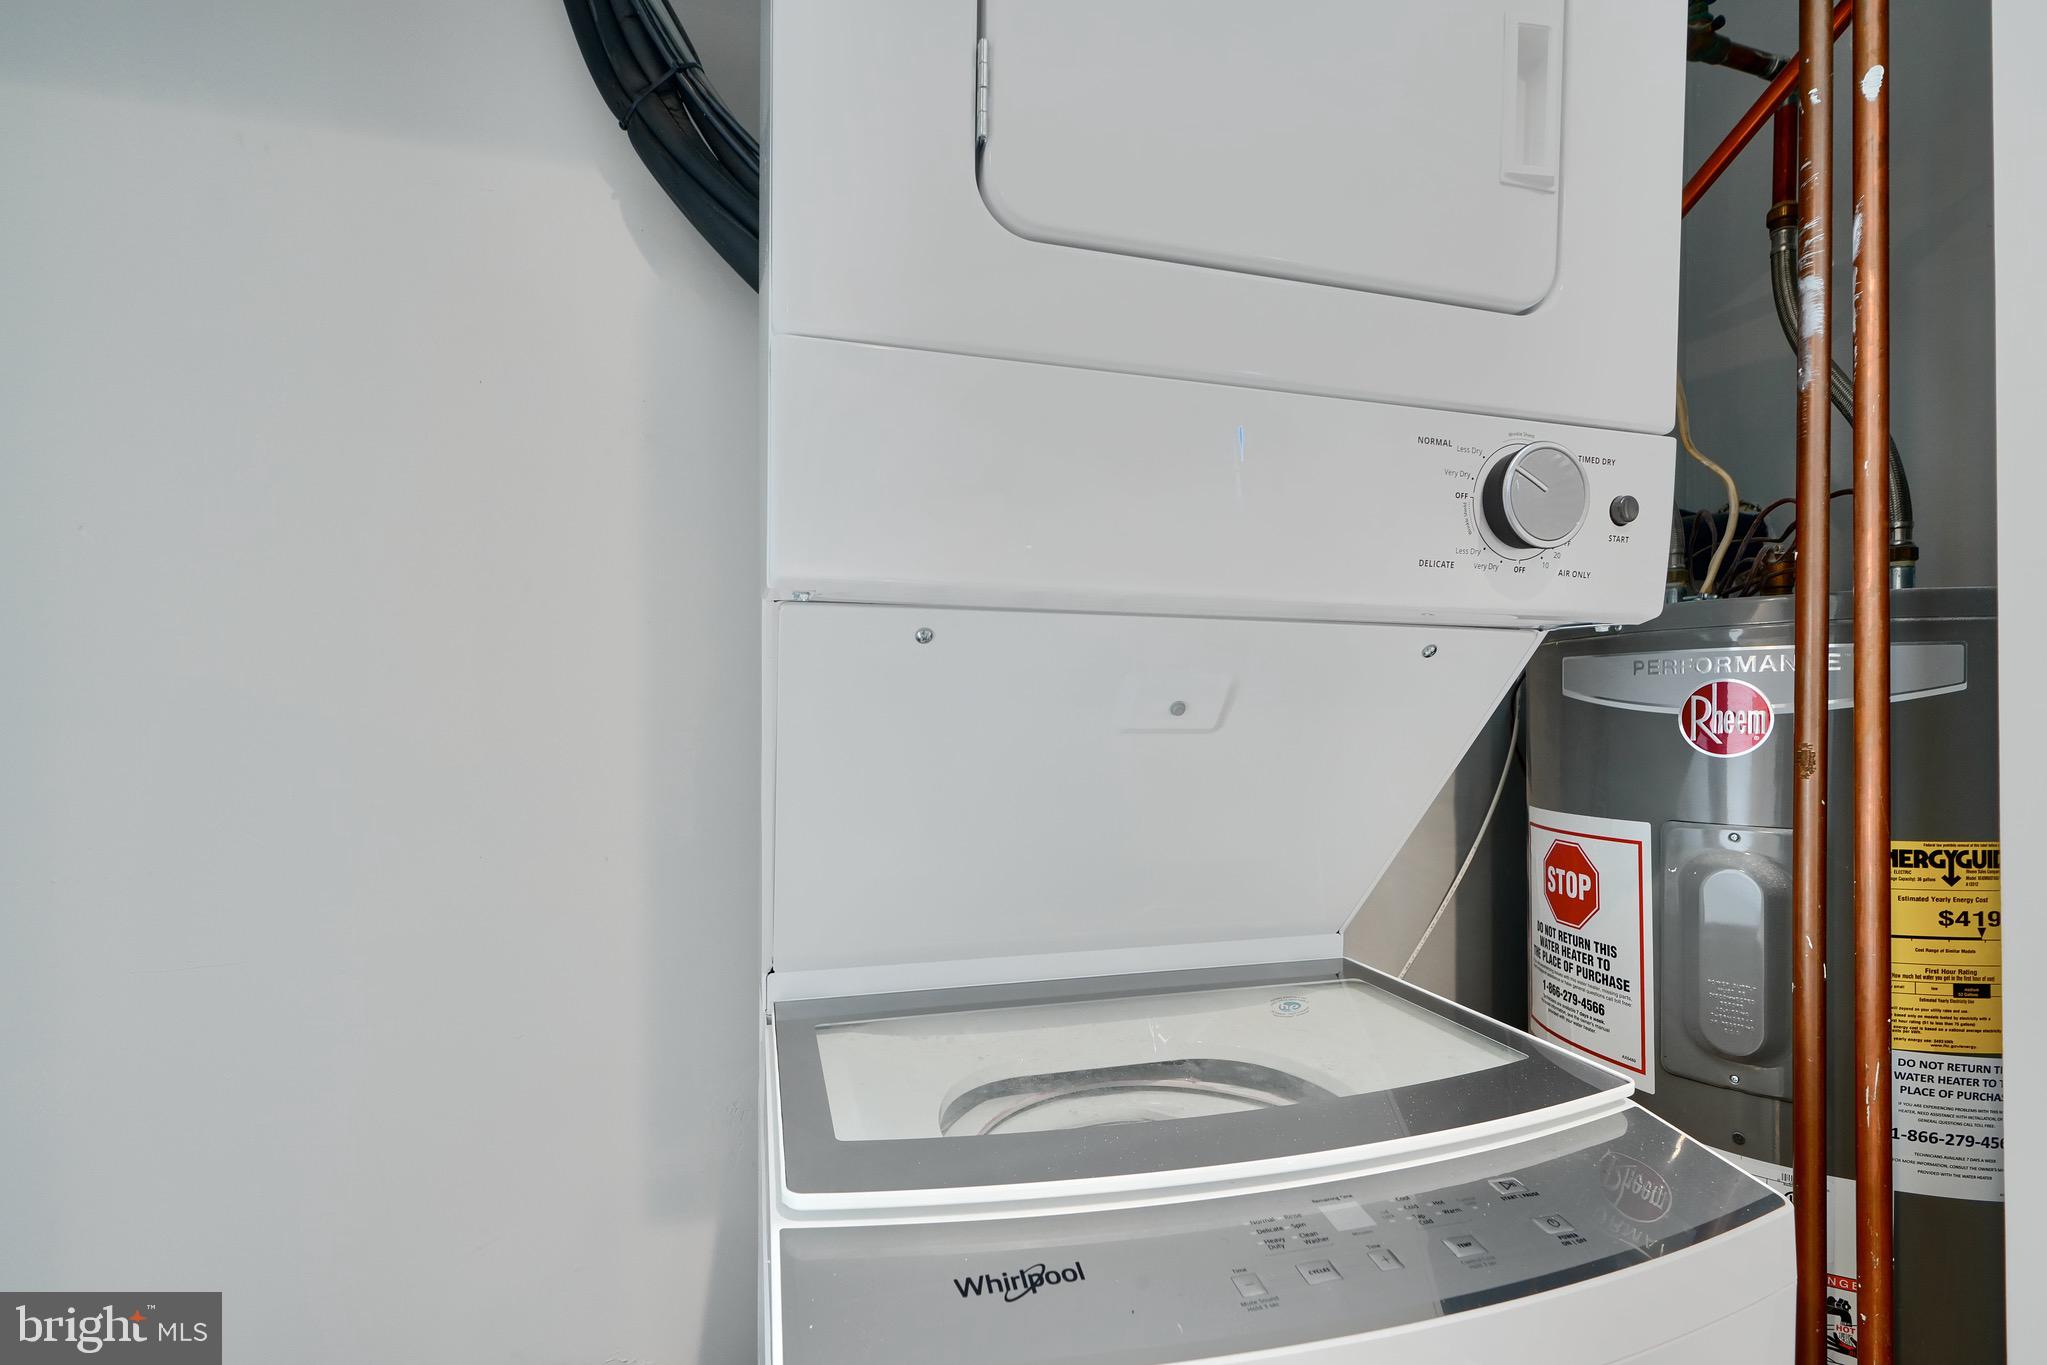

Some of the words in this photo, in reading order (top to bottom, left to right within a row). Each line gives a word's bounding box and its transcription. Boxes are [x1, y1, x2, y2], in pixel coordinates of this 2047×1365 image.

[1417, 436, 1452, 448] NORMAL
[1456, 445, 1471, 454] Less
[1471, 447, 1483, 456] Dry
[1578, 455, 1600, 465] TIMED
[1601, 458, 1616, 467] DRY
[1444, 469, 1459, 478] Very
[1459, 470, 1471, 479] Dry
[1608, 535, 1630, 544] START
[1455, 547, 1469, 555] Less
[1470, 548, 1481, 557] Dry
[1418, 559, 1455, 569] DELICATE
[1474, 562, 1487, 572] Very
[1488, 563, 1499, 573] Dry
[1513, 566, 1526, 574] OFF
[1558, 569, 1571, 578] AIR
[1572, 570, 1591, 579] ONLY
[1633, 652, 1841, 676] PERFORMANE
[1690, 682, 1767, 745] Rheem
[1547, 866, 1591, 901] STOP
[1897, 895, 1929, 903] Estimated
[1931, 896, 1951, 904] Yearly
[1938, 909, 2000, 928] $419
[1537, 920, 1544, 932] DO
[1545, 927, 1557, 939] NOT
[1558, 930, 1591, 951] RETURN
[1593, 940, 1617, 958] THIS
[1540, 935, 1560, 955] WATER
[1561, 945, 1594, 966] HEATER
[1597, 956, 1610, 971] TO
[1542, 950, 1561, 969] PLACE
[1563, 960, 1573, 973] OF
[1576, 964, 1630, 992] PURCHASE
[1542, 979, 1605, 1016] 1-866-279-4566
[1897, 1058, 1916, 1068] DO
[1919, 1061, 1944, 1071] NOT
[1946, 1063, 1991, 1074] RETURN
[1894, 1071, 1935, 1083] WATER
[1937, 1076, 1980, 1087] HEATER
[1982, 1079, 1997, 1088] TO
[1899, 1085, 1935, 1097] PLACE
[1938, 1089, 1954, 1099] OF
[1956, 1091, 2003, 1102] PURCHA
[1249, 1217, 1275, 1225] Normal
[1256, 1226, 1284, 1235] Delicate
[1263, 1237, 1286, 1245] Heavy
[1303, 1237, 1329, 1245] Washer
[1308, 1267, 1331, 1275] CYCLES
[953, 1261, 1085, 1302] Whirlpool
[1835, 1324, 1856, 1335] HOT
